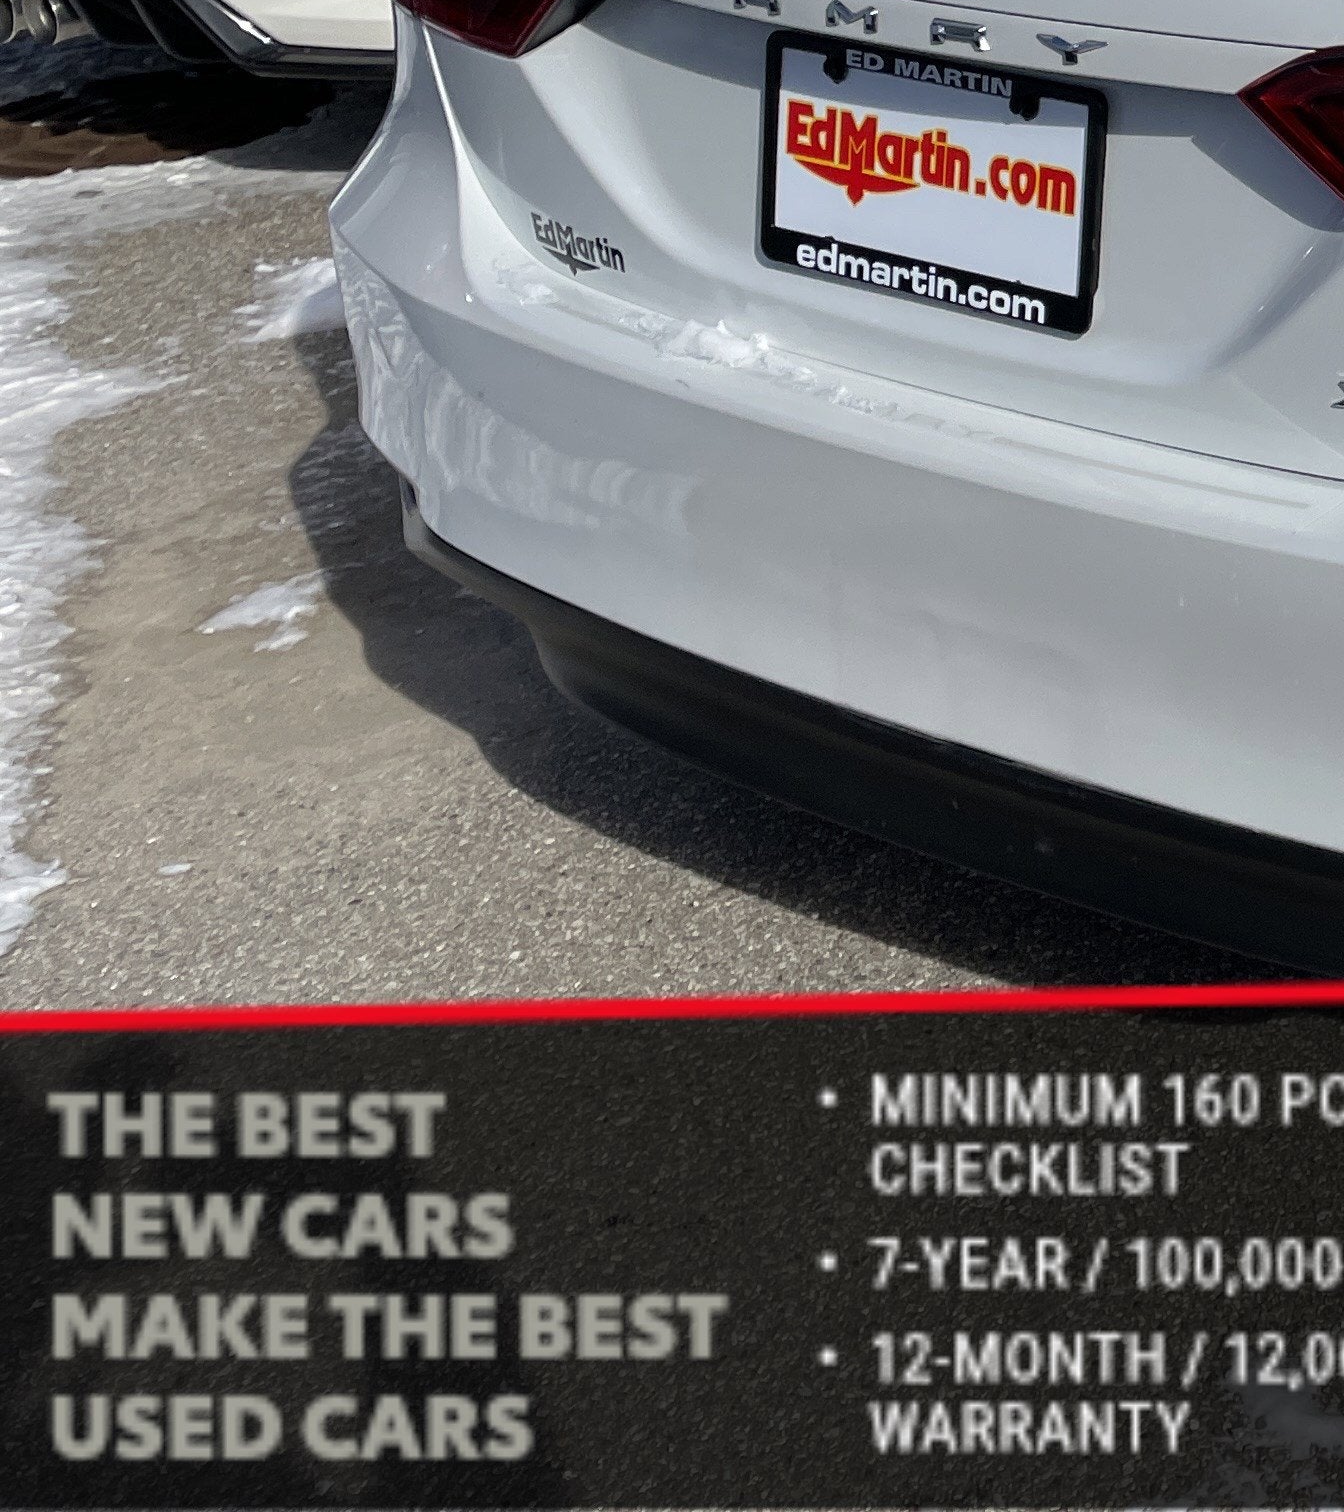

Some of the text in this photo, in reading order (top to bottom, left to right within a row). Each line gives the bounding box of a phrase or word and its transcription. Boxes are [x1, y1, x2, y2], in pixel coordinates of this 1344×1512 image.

[845, 49, 1013, 98] ED MARTIN
[530, 211, 626, 275] EdMartin
[796, 243, 1046, 325] edmartin.com
